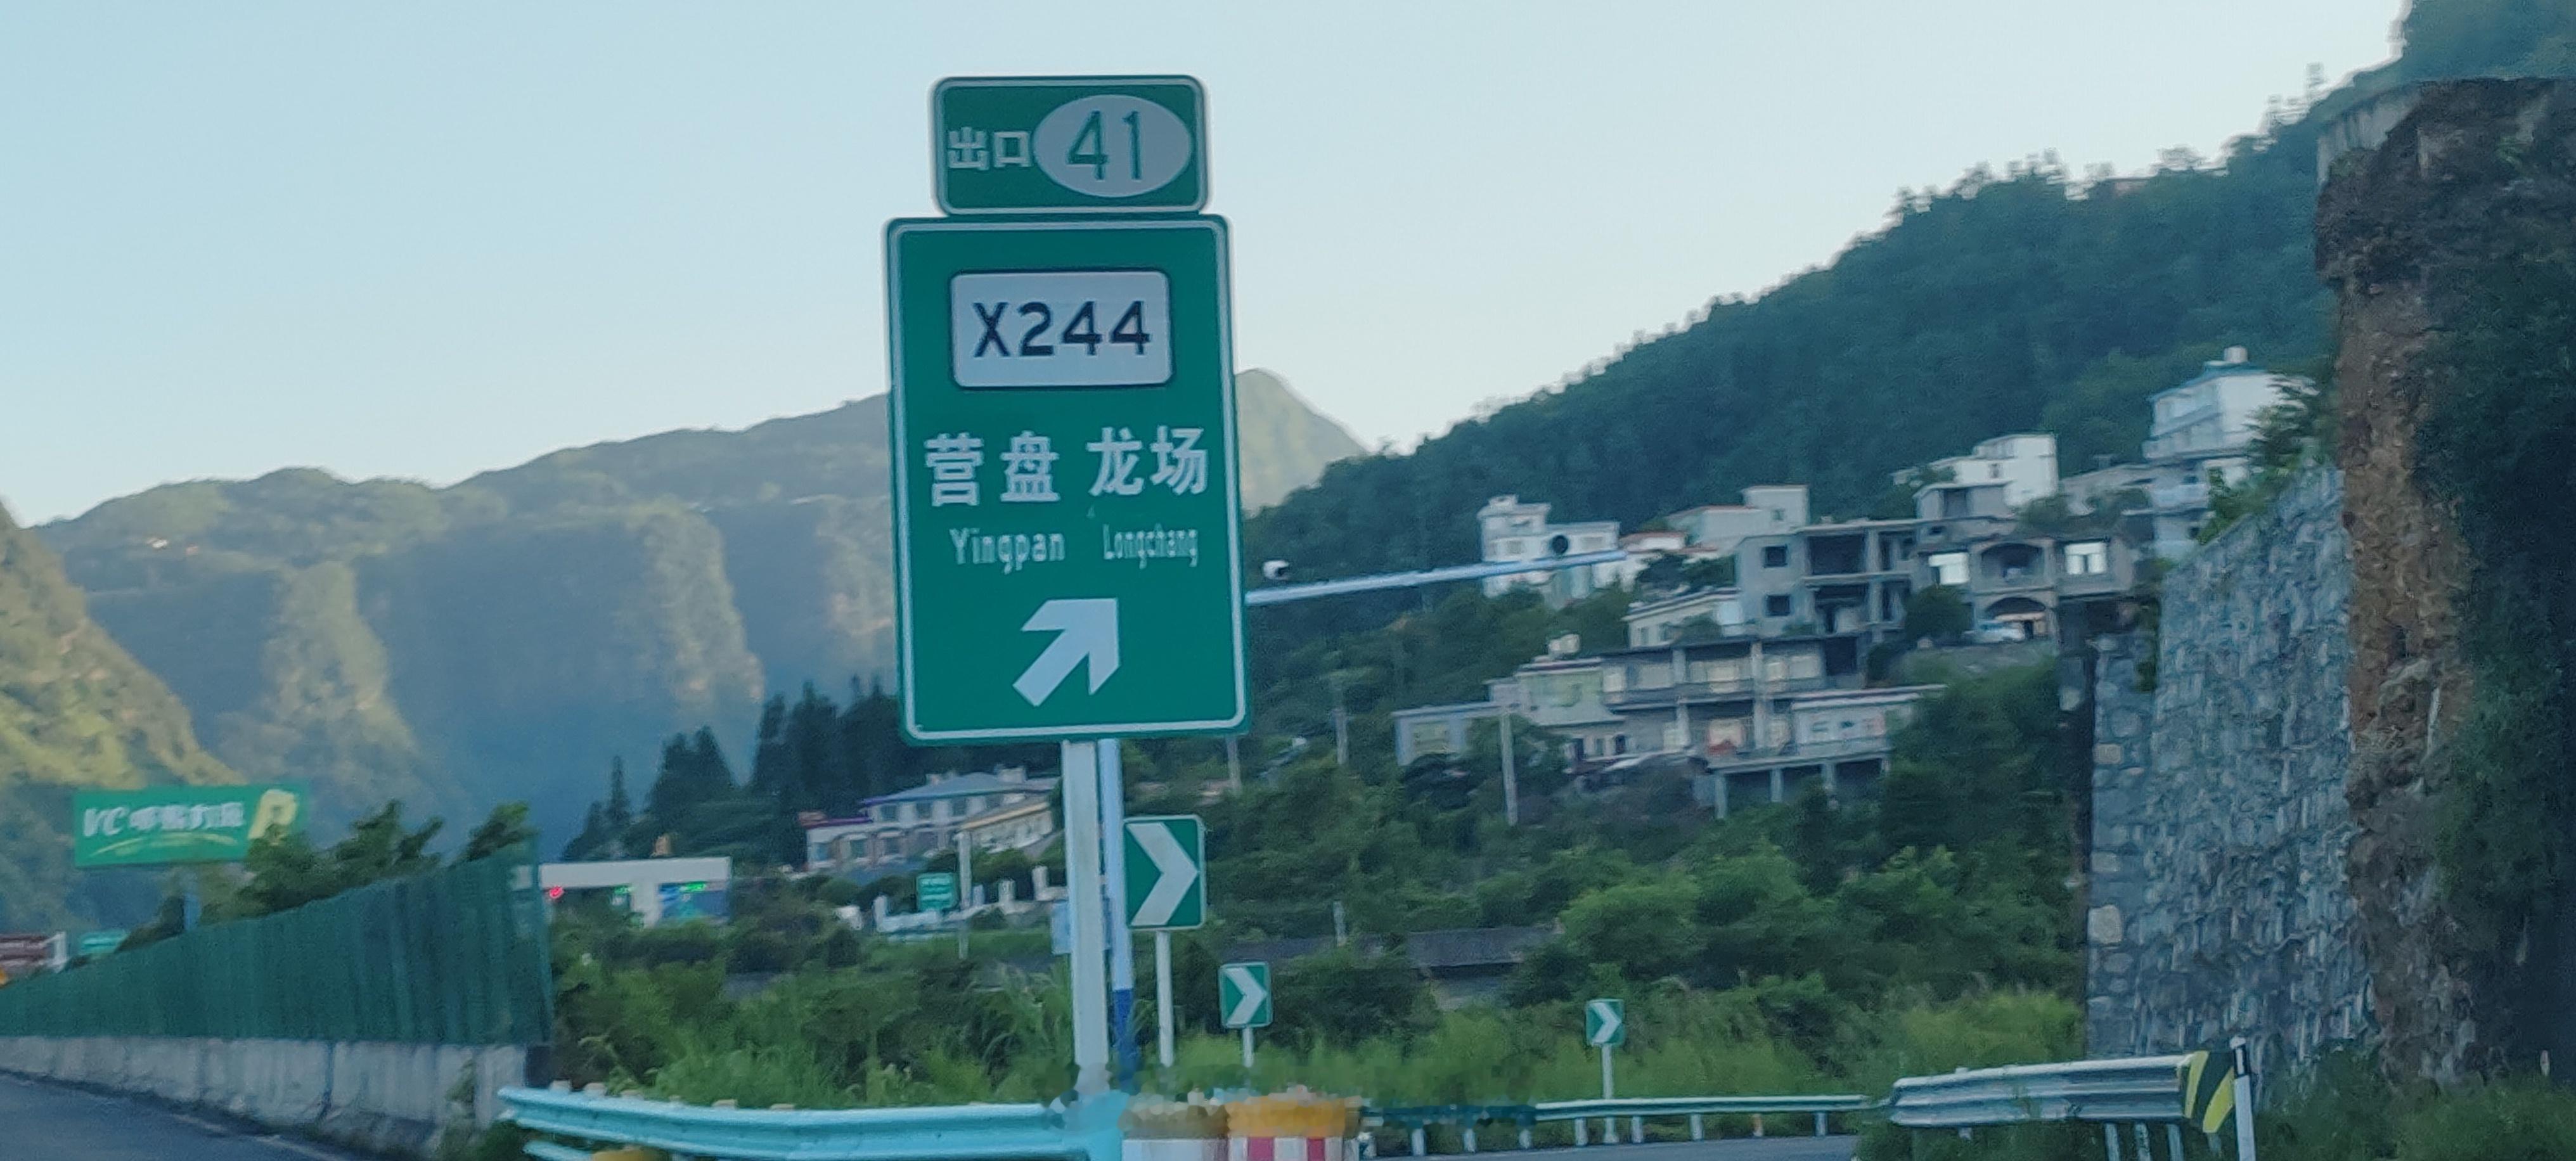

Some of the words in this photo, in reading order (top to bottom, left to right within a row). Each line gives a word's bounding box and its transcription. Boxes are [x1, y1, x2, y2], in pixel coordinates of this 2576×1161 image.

[948, 127, 1033, 170] 出口
[1066, 110, 1142, 181] 41
[972, 300, 1152, 359] X244
[924, 431, 1060, 506] 营盘
[1086, 425, 1208, 496] 龙场
[950, 527, 1066, 574] Yingpan
[1102, 523, 1199, 569] Longchang
